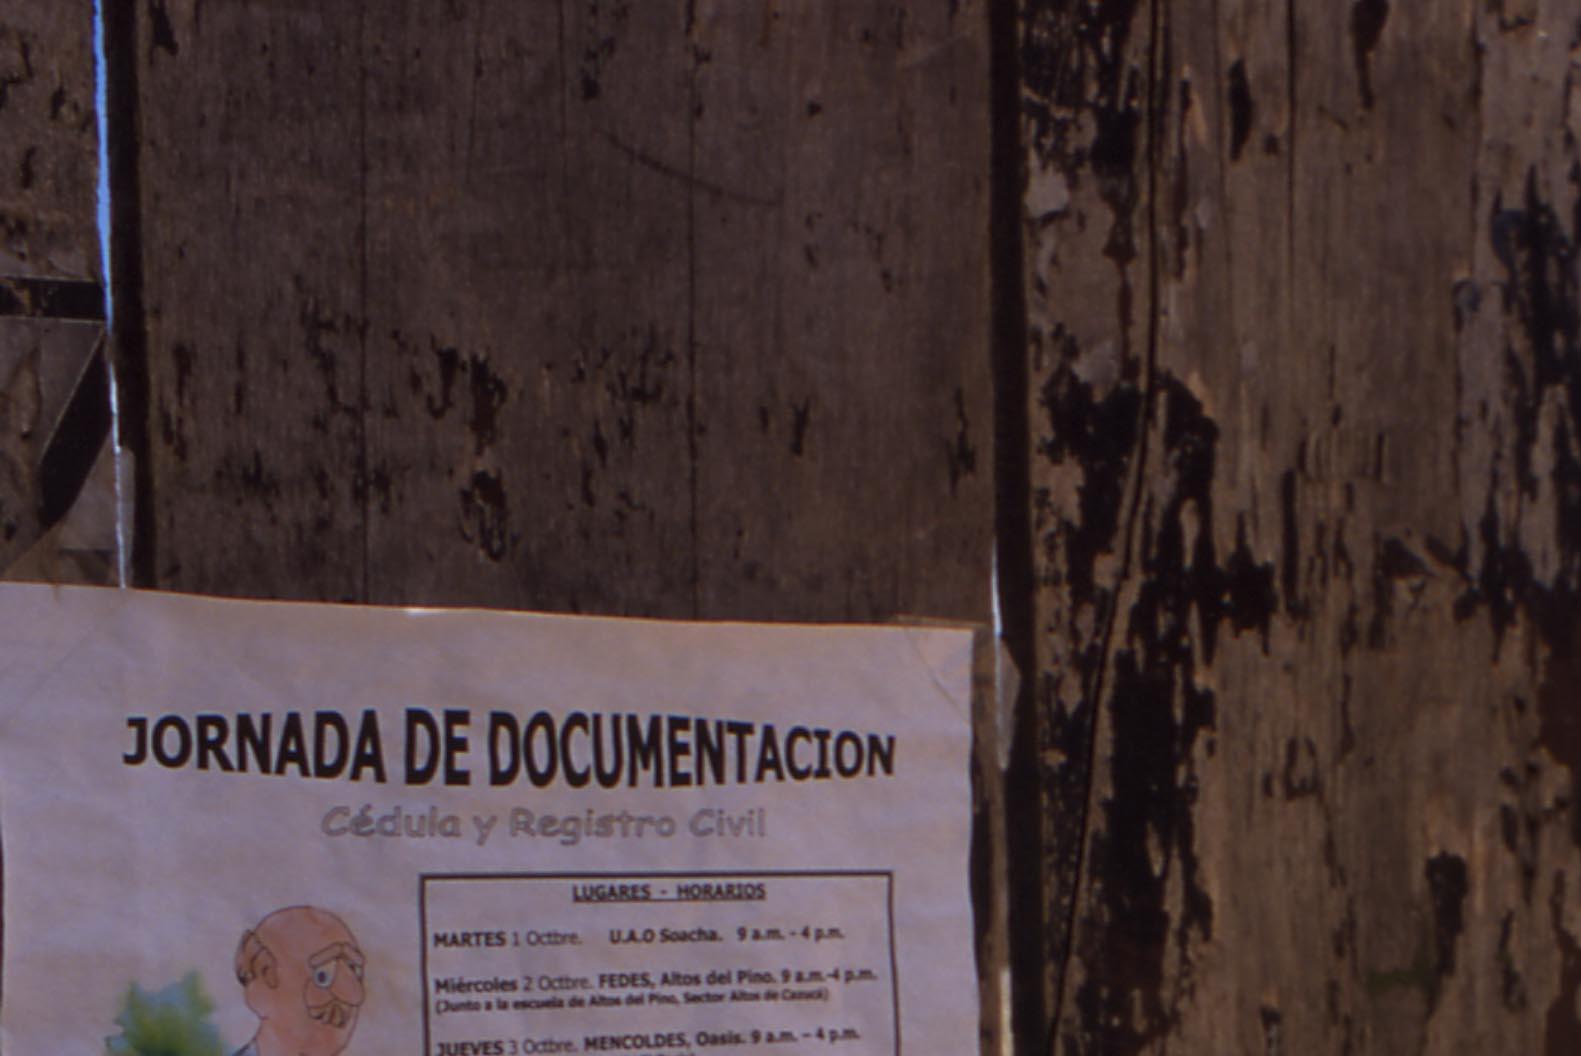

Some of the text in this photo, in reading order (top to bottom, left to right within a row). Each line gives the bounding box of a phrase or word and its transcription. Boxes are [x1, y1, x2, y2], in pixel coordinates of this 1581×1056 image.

[122, 707, 897, 789] JORNADA DE DOCUMENTACION
[320, 803, 768, 846] Cédula y Registro Civil
[572, 884, 651, 902] LUGARES
[676, 883, 766, 900] HORARIOS
[434, 932, 506, 947] MARTES
[512, 933, 520, 946] 1
[609, 929, 655, 943] U.A.O
[660, 927, 723, 942] Soacha.
[737, 926, 747, 940] 9
[752, 929, 785, 940] a.m.
[801, 926, 810, 939] 4
[814, 926, 845, 942] p.m.
[435, 975, 518, 993] Miércoles
[522, 975, 533, 991] 2
[660, 971, 701, 986] Altos
[706, 971, 732, 984] del
[781, 969, 791, 983] 9
[844, 968, 878, 984] p.m.
[509, 1040, 518, 1054] 3
[751, 1029, 762, 1043] 9
[765, 1030, 798, 1042] a.m.
[816, 1028, 825, 1040] 4
[829, 1028, 860, 1043] p.m.
